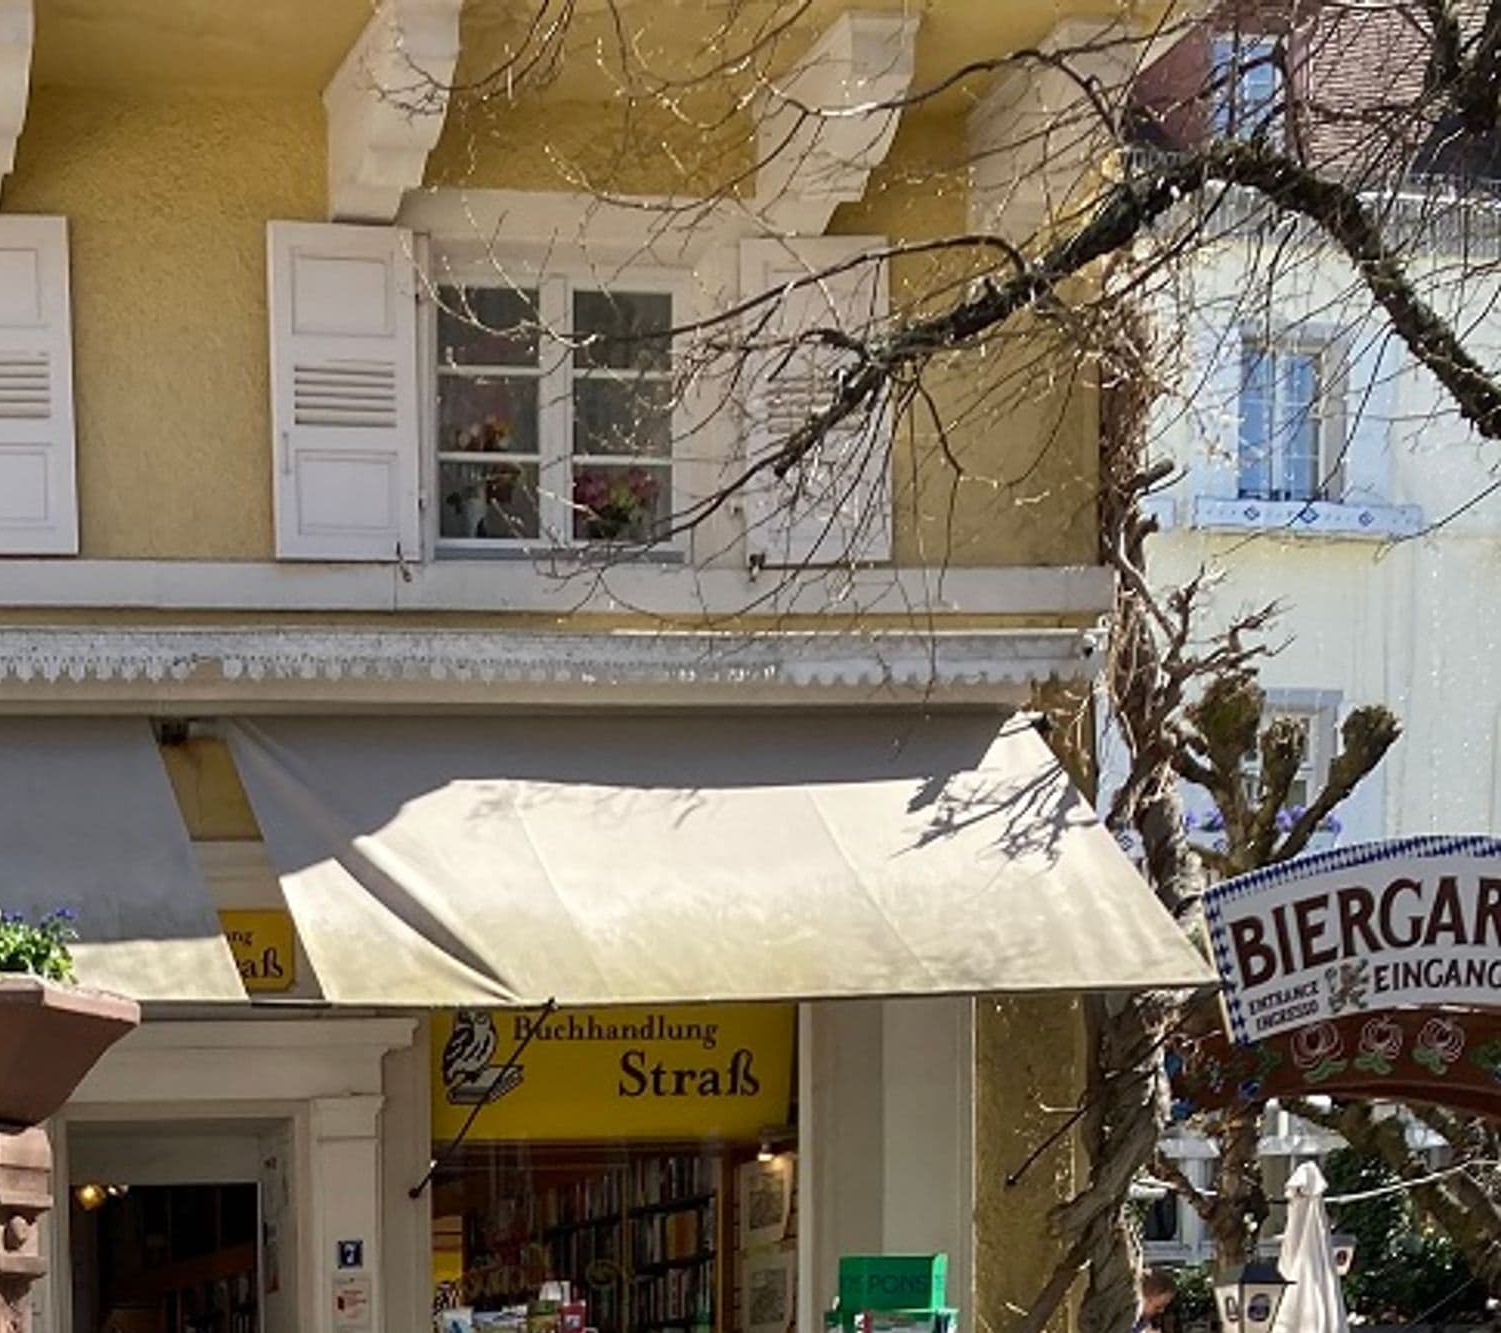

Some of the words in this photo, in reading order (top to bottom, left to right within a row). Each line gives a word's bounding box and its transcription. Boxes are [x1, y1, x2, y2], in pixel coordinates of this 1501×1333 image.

[1249, 981, 1319, 1015] ENTRANCE
[514, 1014, 719, 1049] Buchhandlung
[1256, 1000, 1319, 1031] INGRESSO
[618, 1049, 759, 1097] Straß
[868, 1273, 926, 1294] PONS
